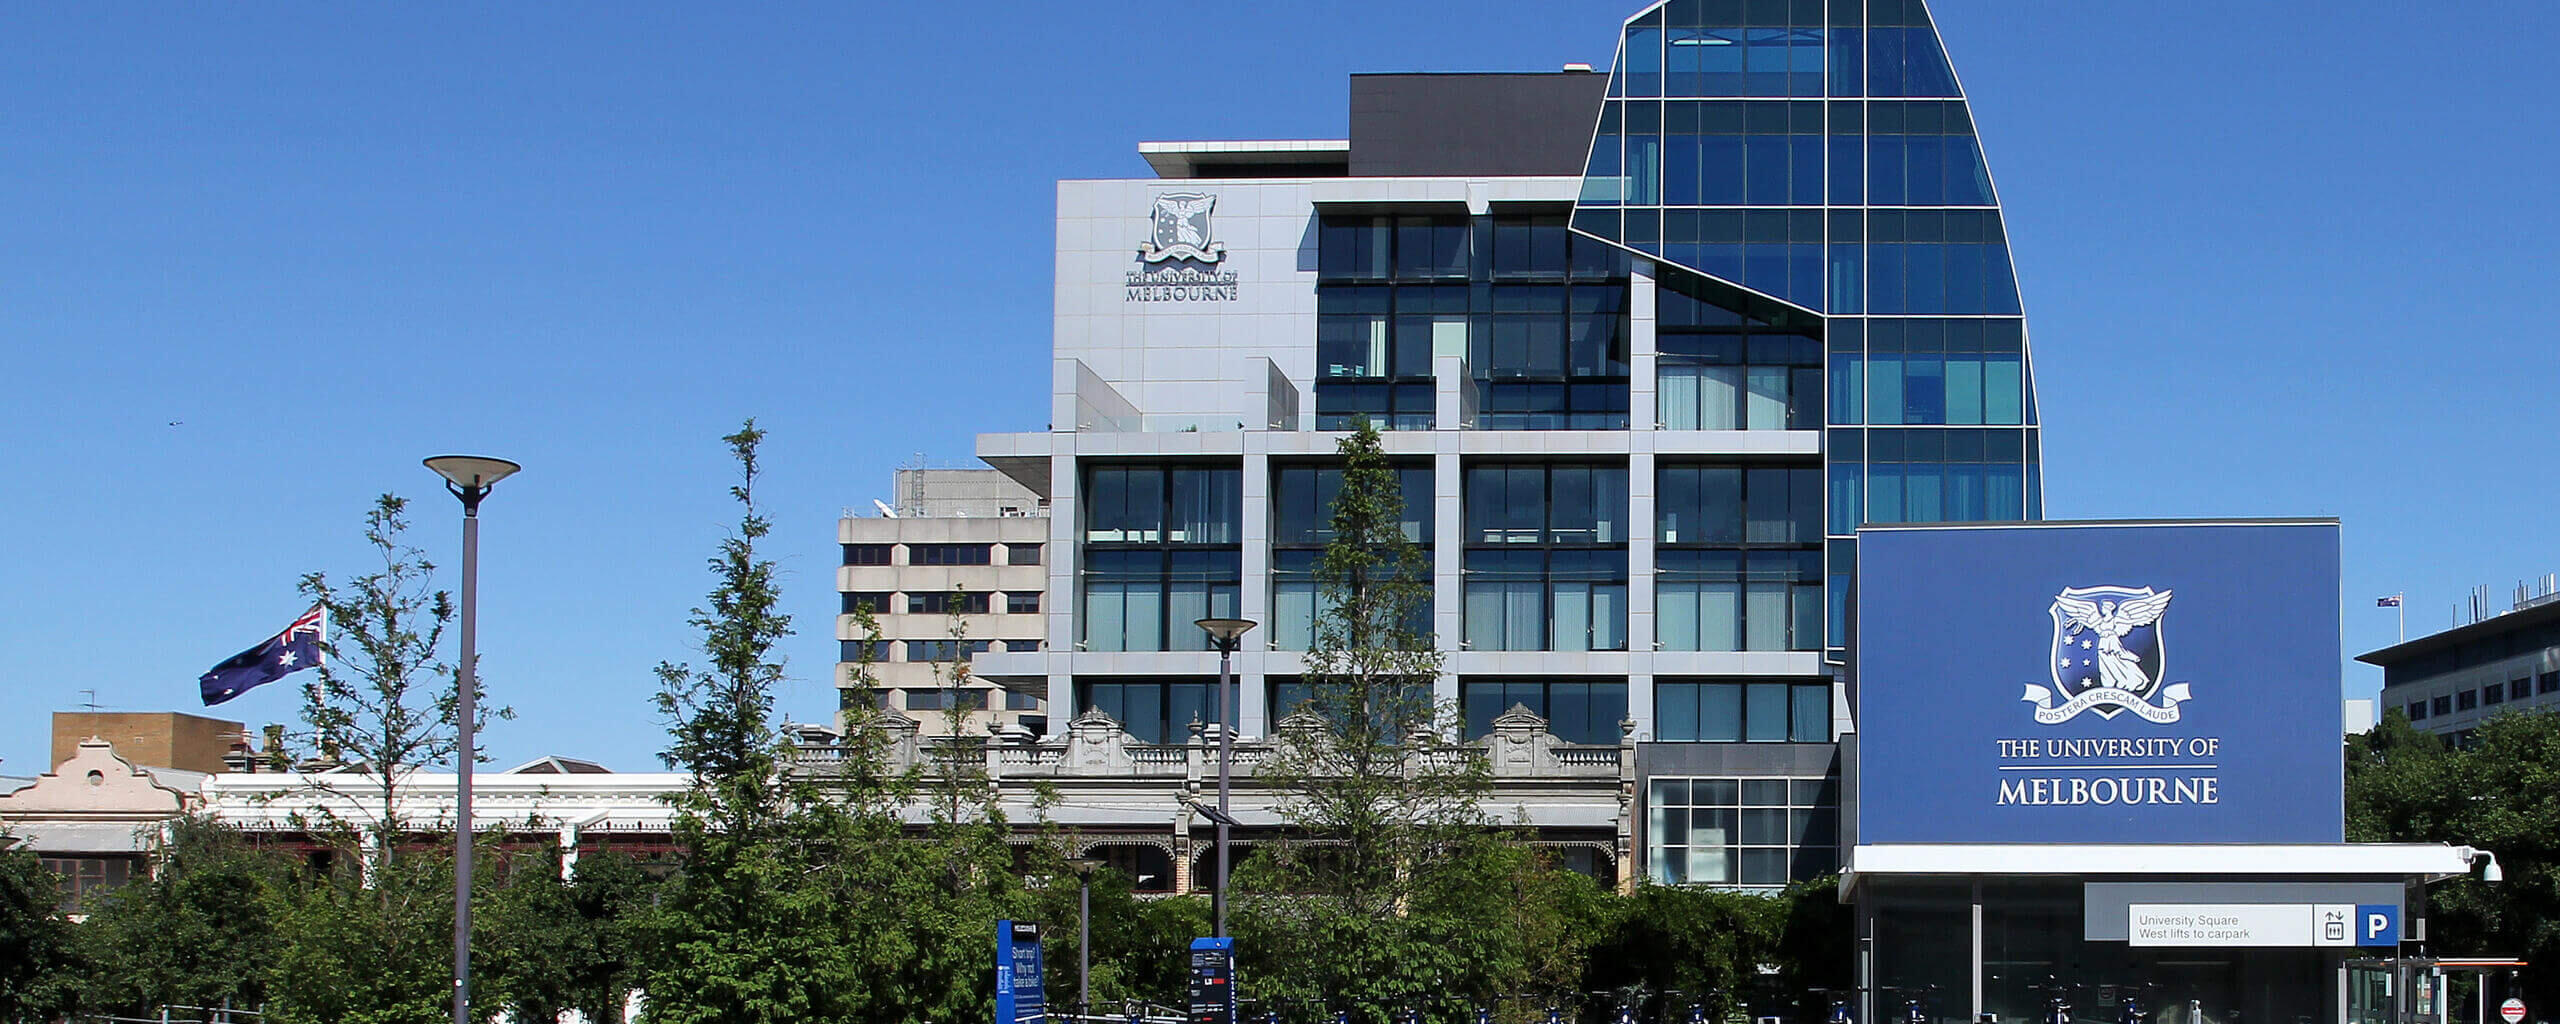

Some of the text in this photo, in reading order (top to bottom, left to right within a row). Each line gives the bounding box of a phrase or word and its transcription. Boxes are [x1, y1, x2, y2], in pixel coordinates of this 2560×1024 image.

[1126, 270, 1238, 283] THE UNIVERSITY OF
[1126, 286, 1238, 301] MELBOURNE
[2038, 691, 2176, 720] POSTERA CRESCAM LAUDE
[1996, 738, 2218, 757] THE UNIVERSITY OF
[1996, 777, 2218, 805] MELBOURNE
[2139, 914, 2239, 927] University Square
[2368, 914, 2388, 939] P
[2139, 928, 2250, 941] West lifts to carpark
